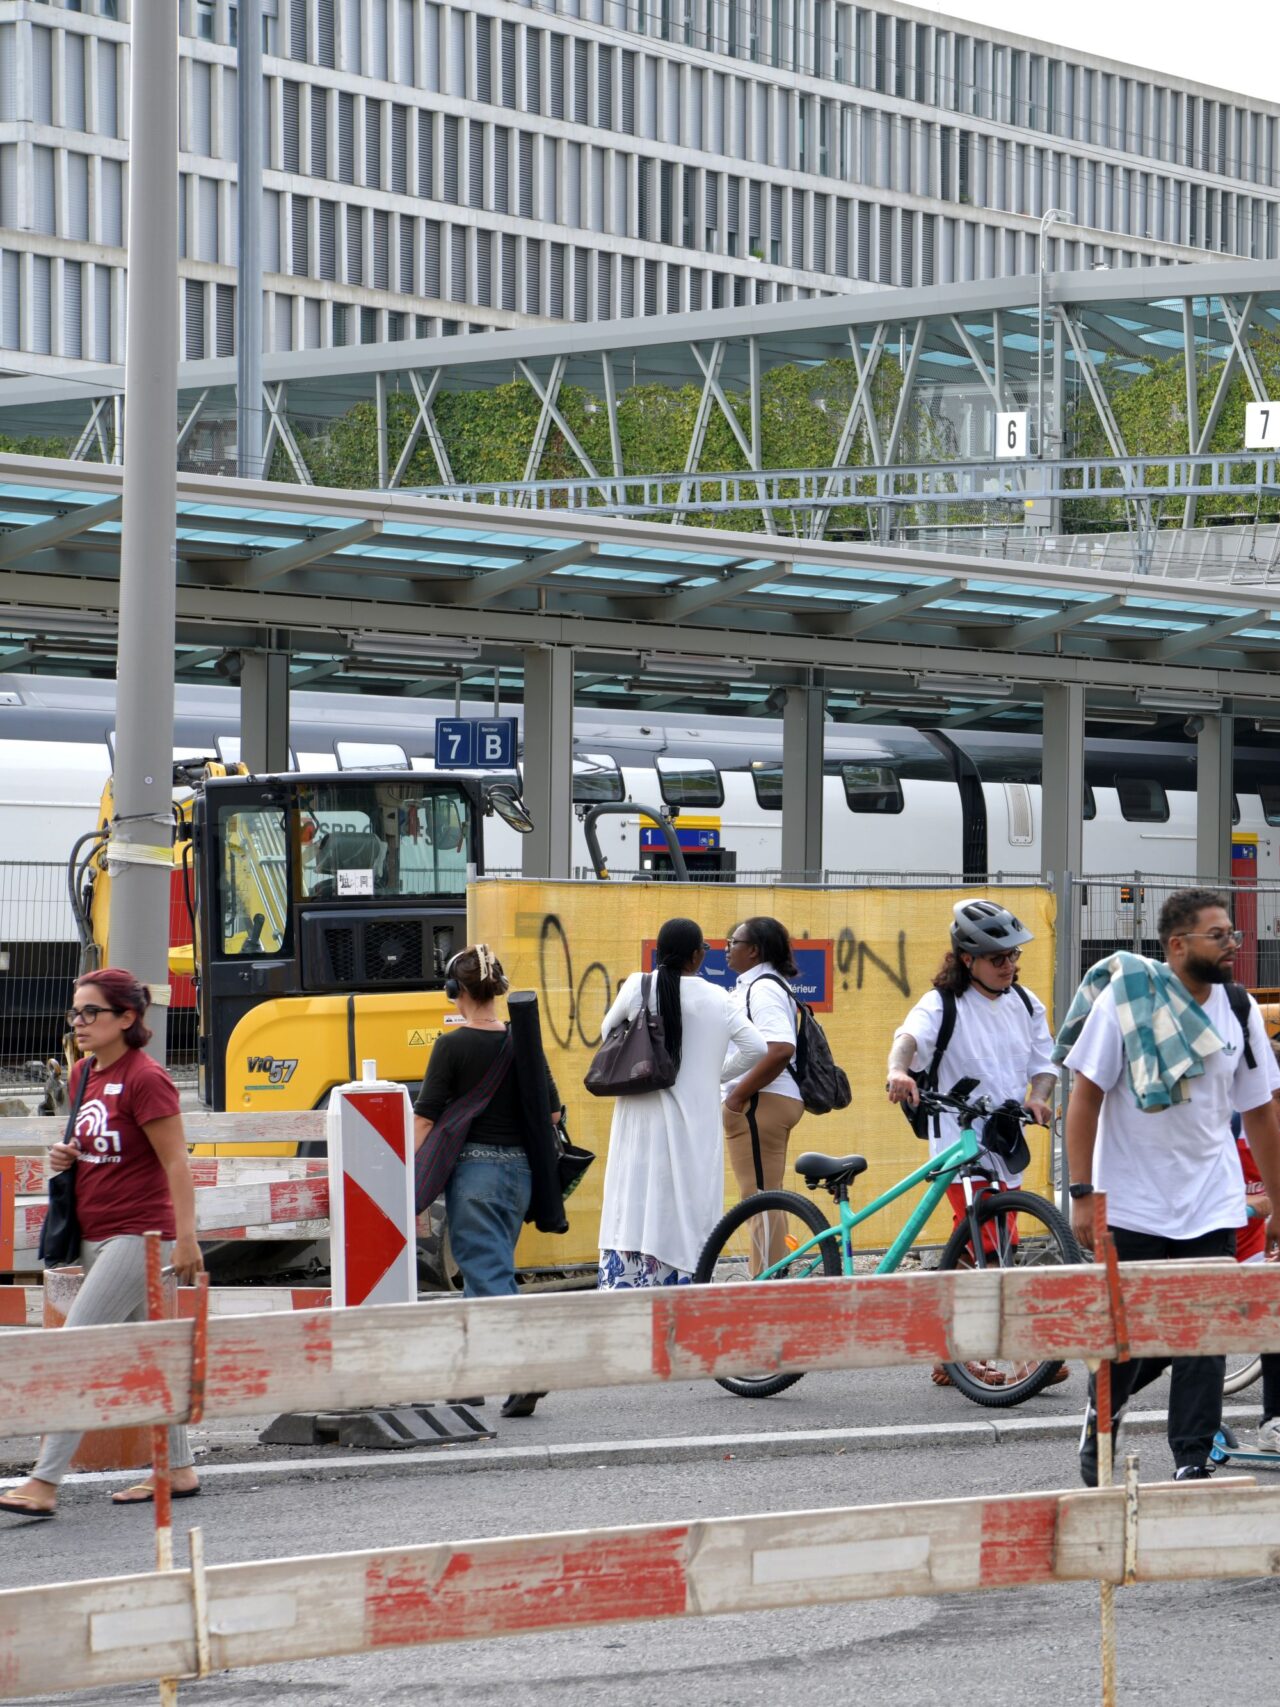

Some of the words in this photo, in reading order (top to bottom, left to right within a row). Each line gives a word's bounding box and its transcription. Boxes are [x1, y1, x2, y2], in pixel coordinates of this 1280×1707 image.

[1007, 420, 1017, 449] 6
[1260, 410, 1270, 440] 7
[448, 735, 462, 760] 7
[485, 734, 502, 760] B
[645, 829, 652, 845] 1
